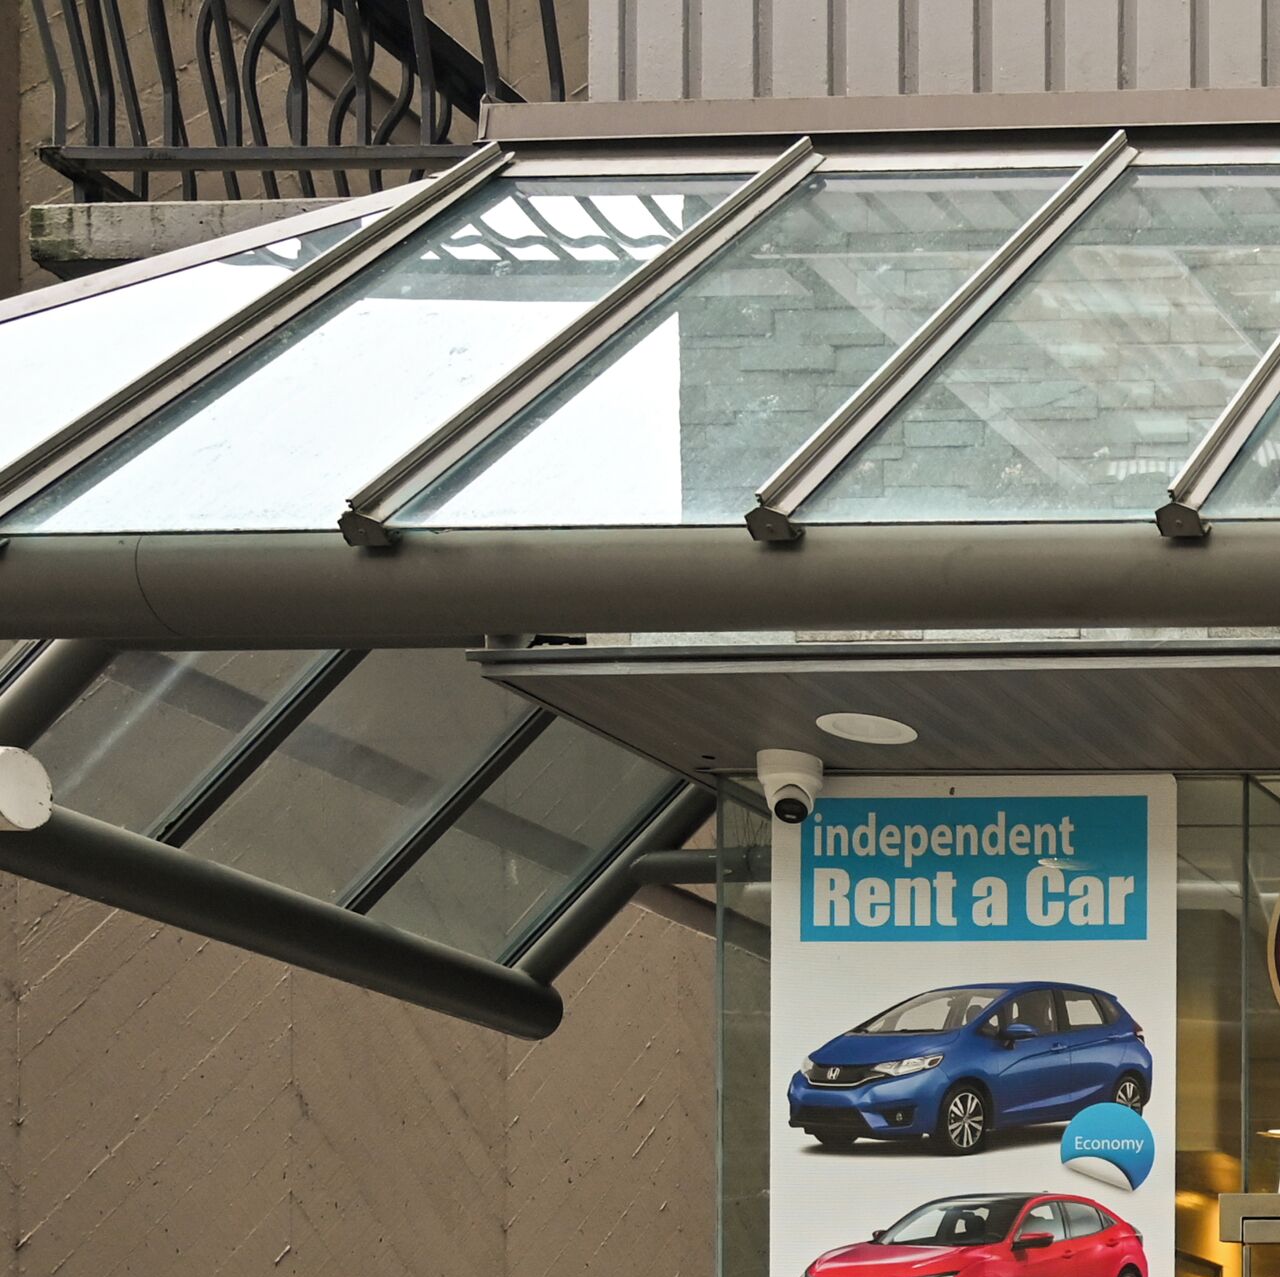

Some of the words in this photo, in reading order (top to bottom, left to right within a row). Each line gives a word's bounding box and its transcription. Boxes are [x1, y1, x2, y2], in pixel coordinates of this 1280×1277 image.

[813, 811, 1075, 868] independent
[813, 867, 957, 927] Rent
[971, 880, 1009, 927] a
[1025, 865, 1135, 926] Car
[1074, 1135, 1145, 1153] Economy
